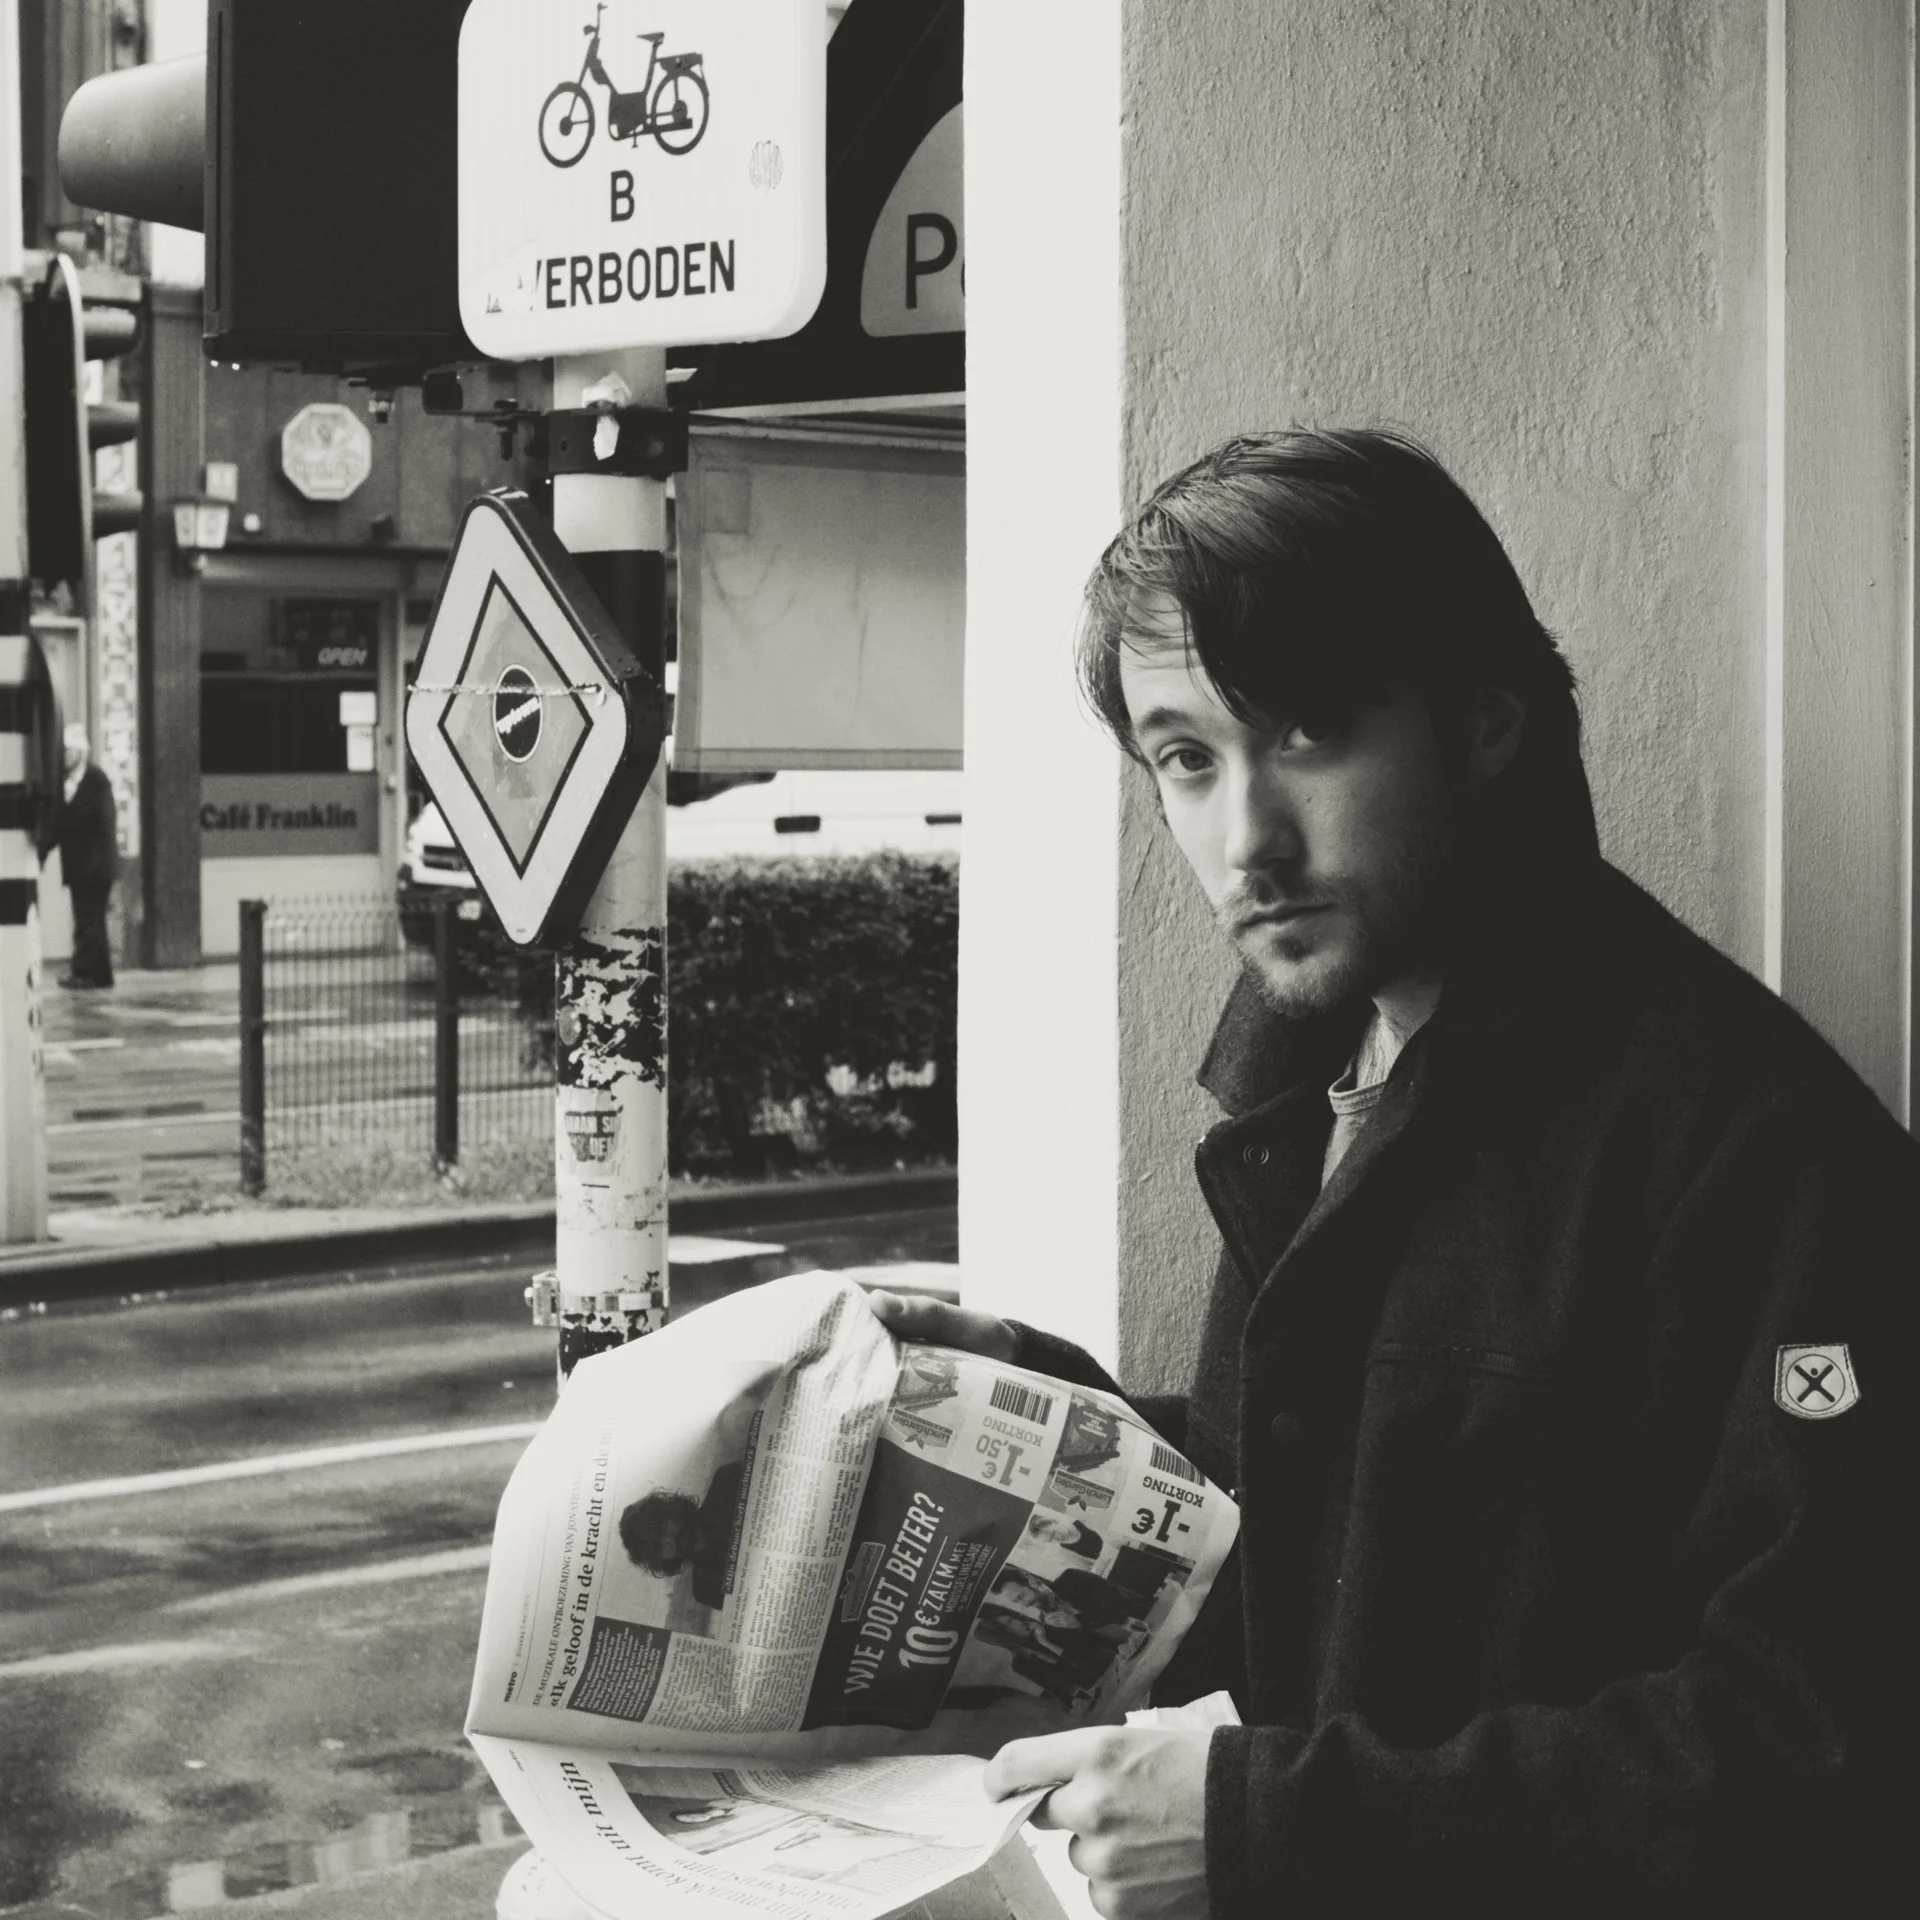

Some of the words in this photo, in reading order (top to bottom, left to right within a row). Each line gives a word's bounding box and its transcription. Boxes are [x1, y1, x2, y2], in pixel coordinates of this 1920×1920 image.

[611, 170, 635, 222] B
[906, 212, 965, 310] P
[318, 647, 367, 666] OPEN
[256, 801, 358, 831] Franklin
[981, 1415, 1045, 1448] KORTING
[592, 1445, 611, 1468] de
[591, 1470, 606, 1493] en
[1141, 1474, 1205, 1508] KORTING
[563, 1530, 576, 1555] VAN
[580, 1496, 604, 1559] kracht
[886, 1491, 945, 1583] BETER?
[575, 1562, 594, 1588] de
[922, 1561, 959, 1612] ZALM
[950, 1541, 969, 1567] MET
[572, 1586, 590, 1612] in
[860, 1576, 909, 1642] DOET
[561, 1613, 586, 1677] geloof
[537, 1639, 560, 1691] MUZIKALE
[844, 1644, 884, 1695] WIE
[503, 1670, 518, 1703] metro
[533, 1690, 545, 1706] DE
[560, 1762, 605, 1816] mijn
[595, 1822, 631, 1849] uit
[624, 1854, 687, 1887] komt
